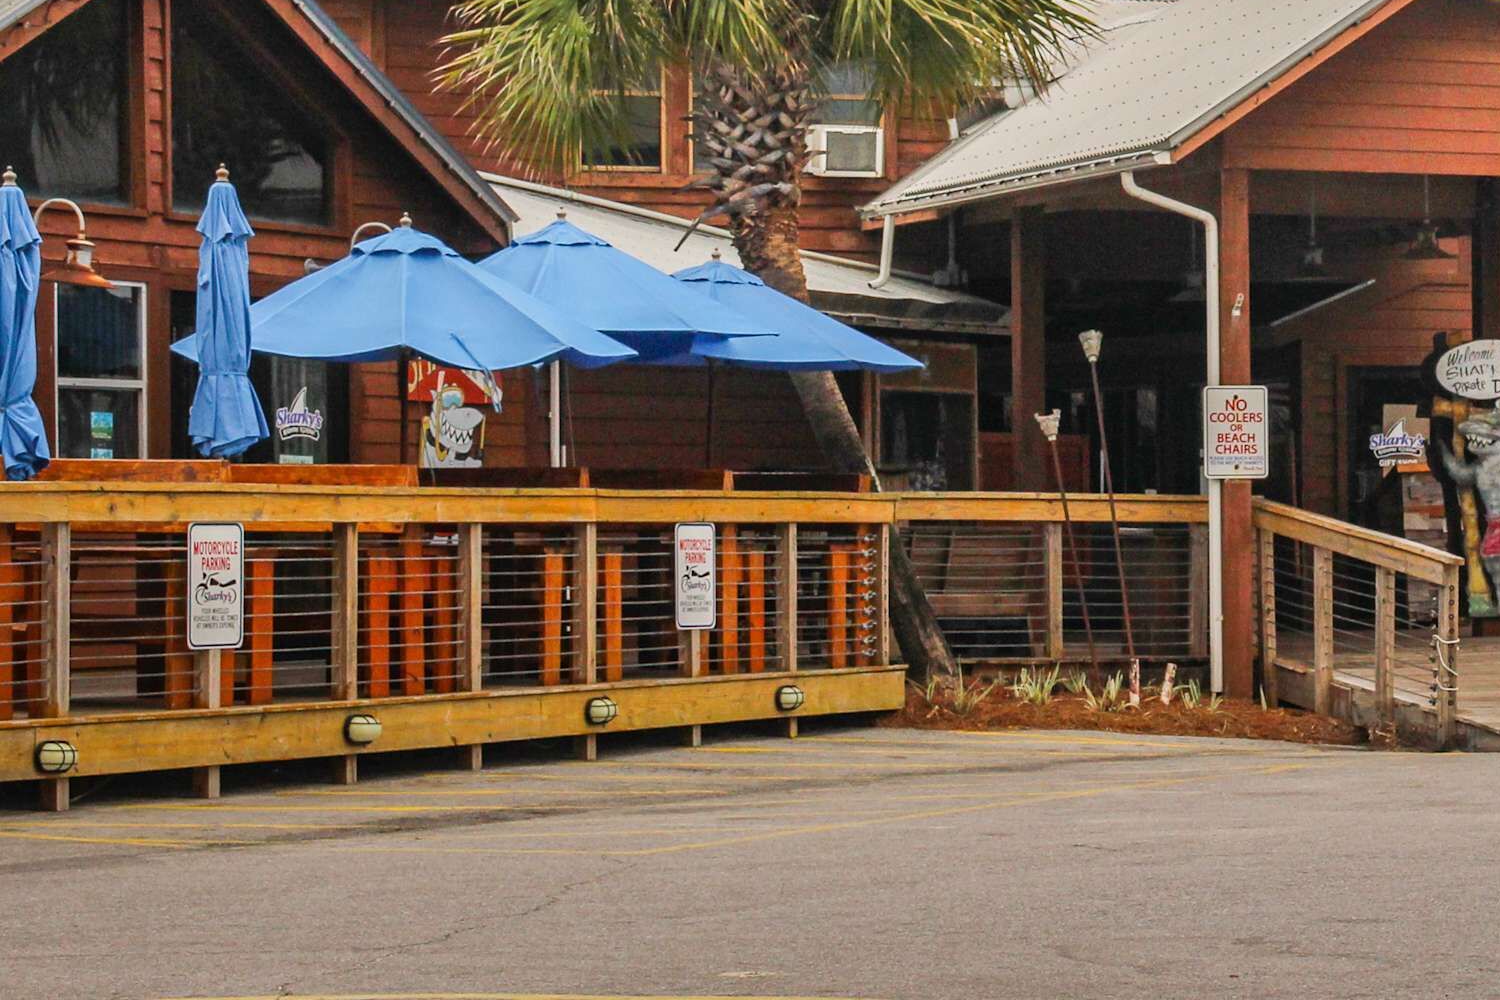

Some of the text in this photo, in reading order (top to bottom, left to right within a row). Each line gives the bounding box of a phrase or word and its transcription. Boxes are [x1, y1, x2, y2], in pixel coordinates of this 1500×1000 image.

[1447, 346, 1495, 367] Welcome
[1225, 399, 1247, 411] NO
[276, 407, 322, 429] Sharky's
[1209, 412, 1263, 423] COOLERS
[1230, 424, 1243, 432] OR
[1217, 433, 1256, 443] BEACH
[1370, 433, 1425, 449] Sharky's
[1215, 444, 1258, 454] CHAIRS
[193, 541, 238, 555] MOTORCYCLE
[201, 557, 231, 570] PARKING
